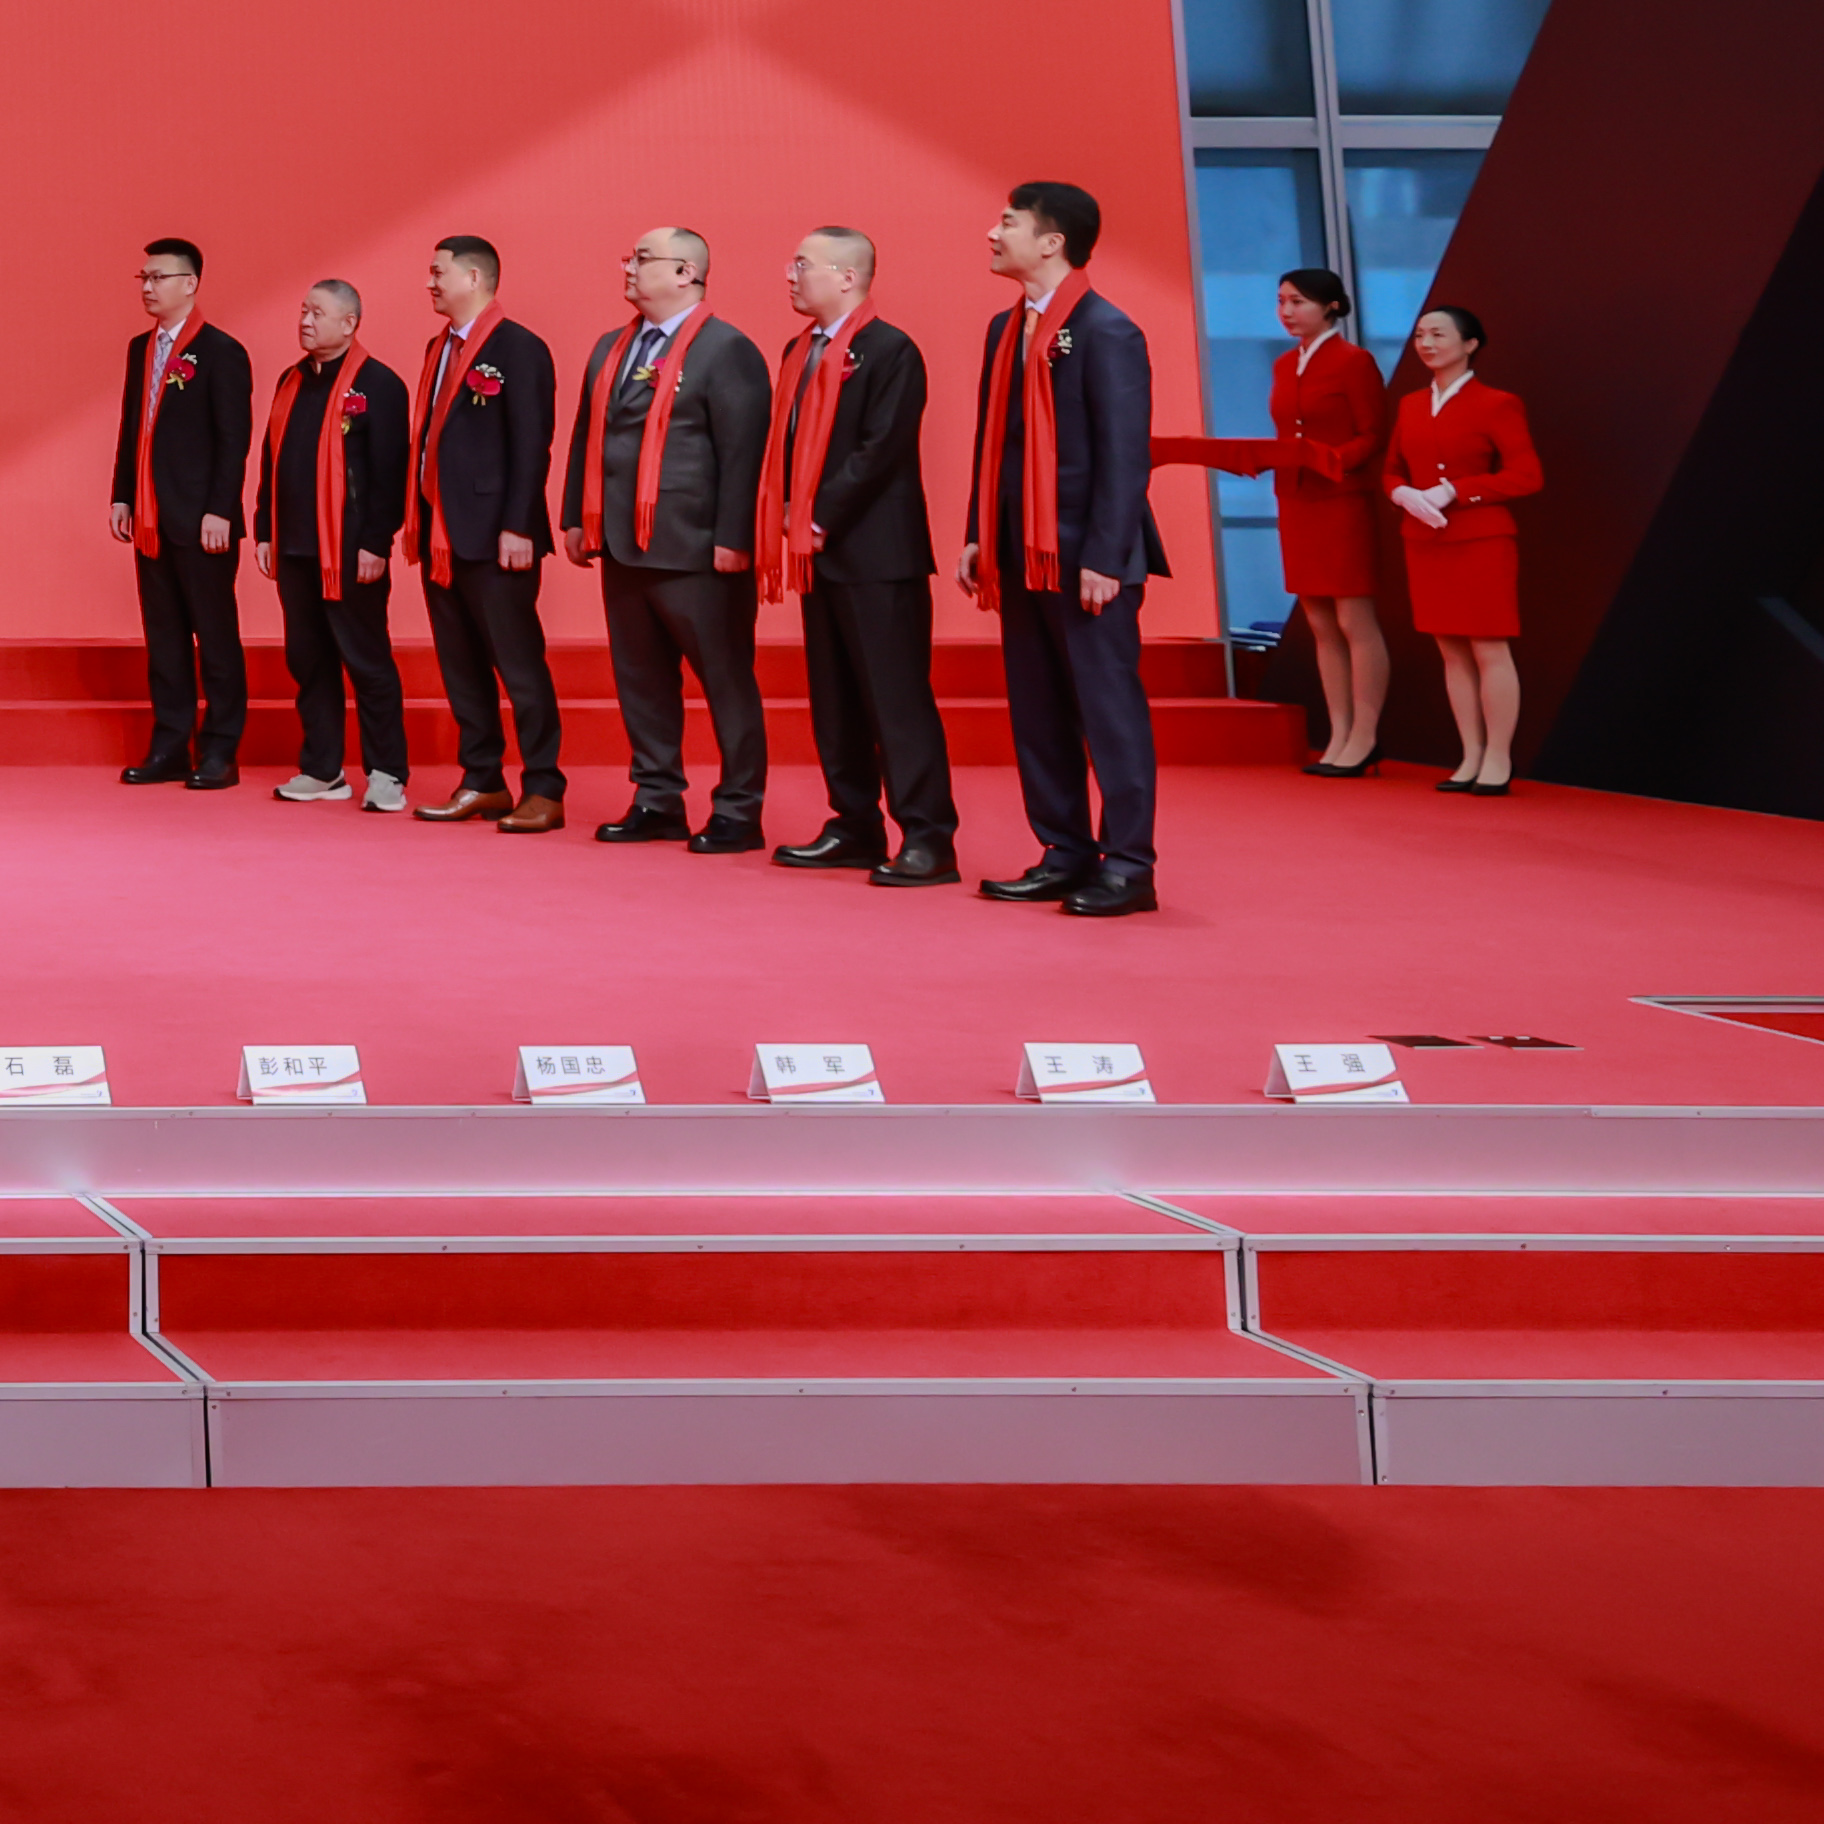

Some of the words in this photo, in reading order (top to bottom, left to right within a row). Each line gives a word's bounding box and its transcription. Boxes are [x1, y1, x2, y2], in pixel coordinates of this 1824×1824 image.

[259, 1056, 328, 1076] 彭和平
[536, 1055, 606, 1075] 杨国忠
